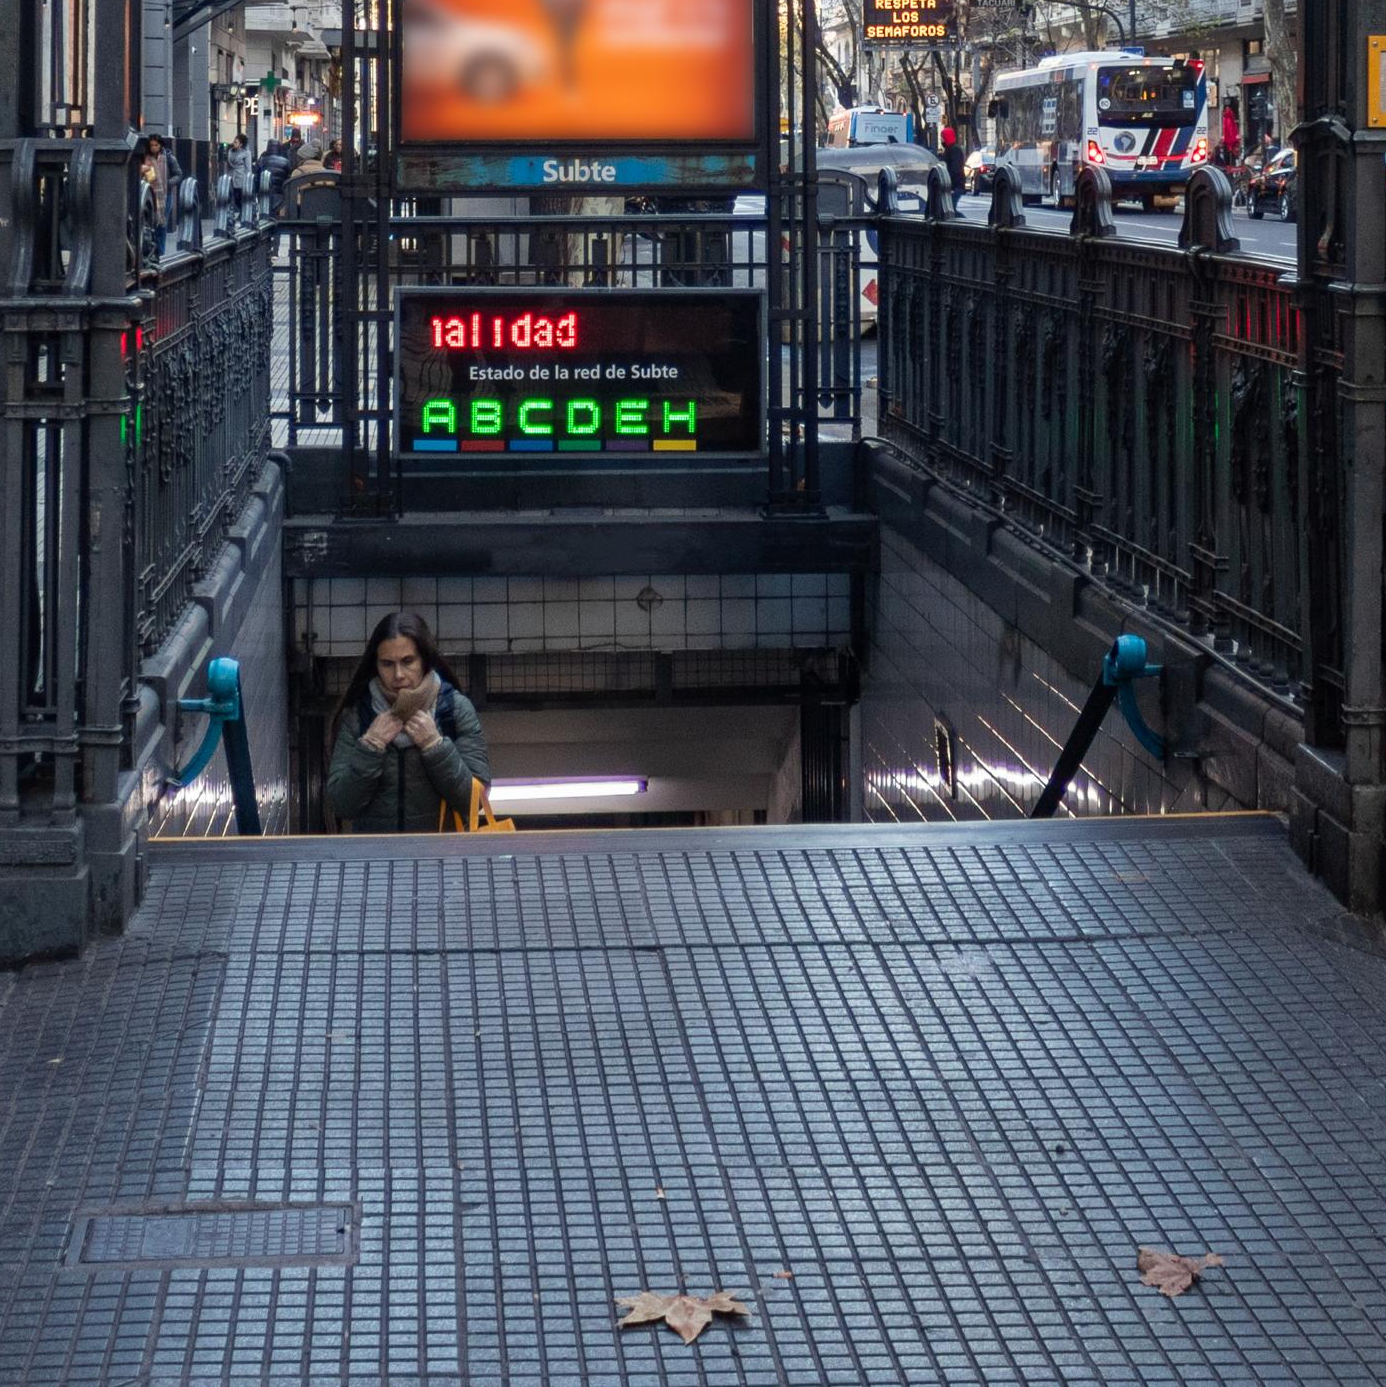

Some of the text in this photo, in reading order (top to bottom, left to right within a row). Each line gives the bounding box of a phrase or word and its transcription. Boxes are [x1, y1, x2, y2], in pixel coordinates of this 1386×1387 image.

[892, 11, 920, 24] LOS
[866, 24, 946, 39] SEMAFOROS
[1087, 127, 1099, 135] 22
[1196, 126, 1207, 135] 22
[542, 158, 617, 183] Subte
[469, 363, 679, 381] Estado de la red de Subte
[422, 401, 696, 434] A B C D E H
